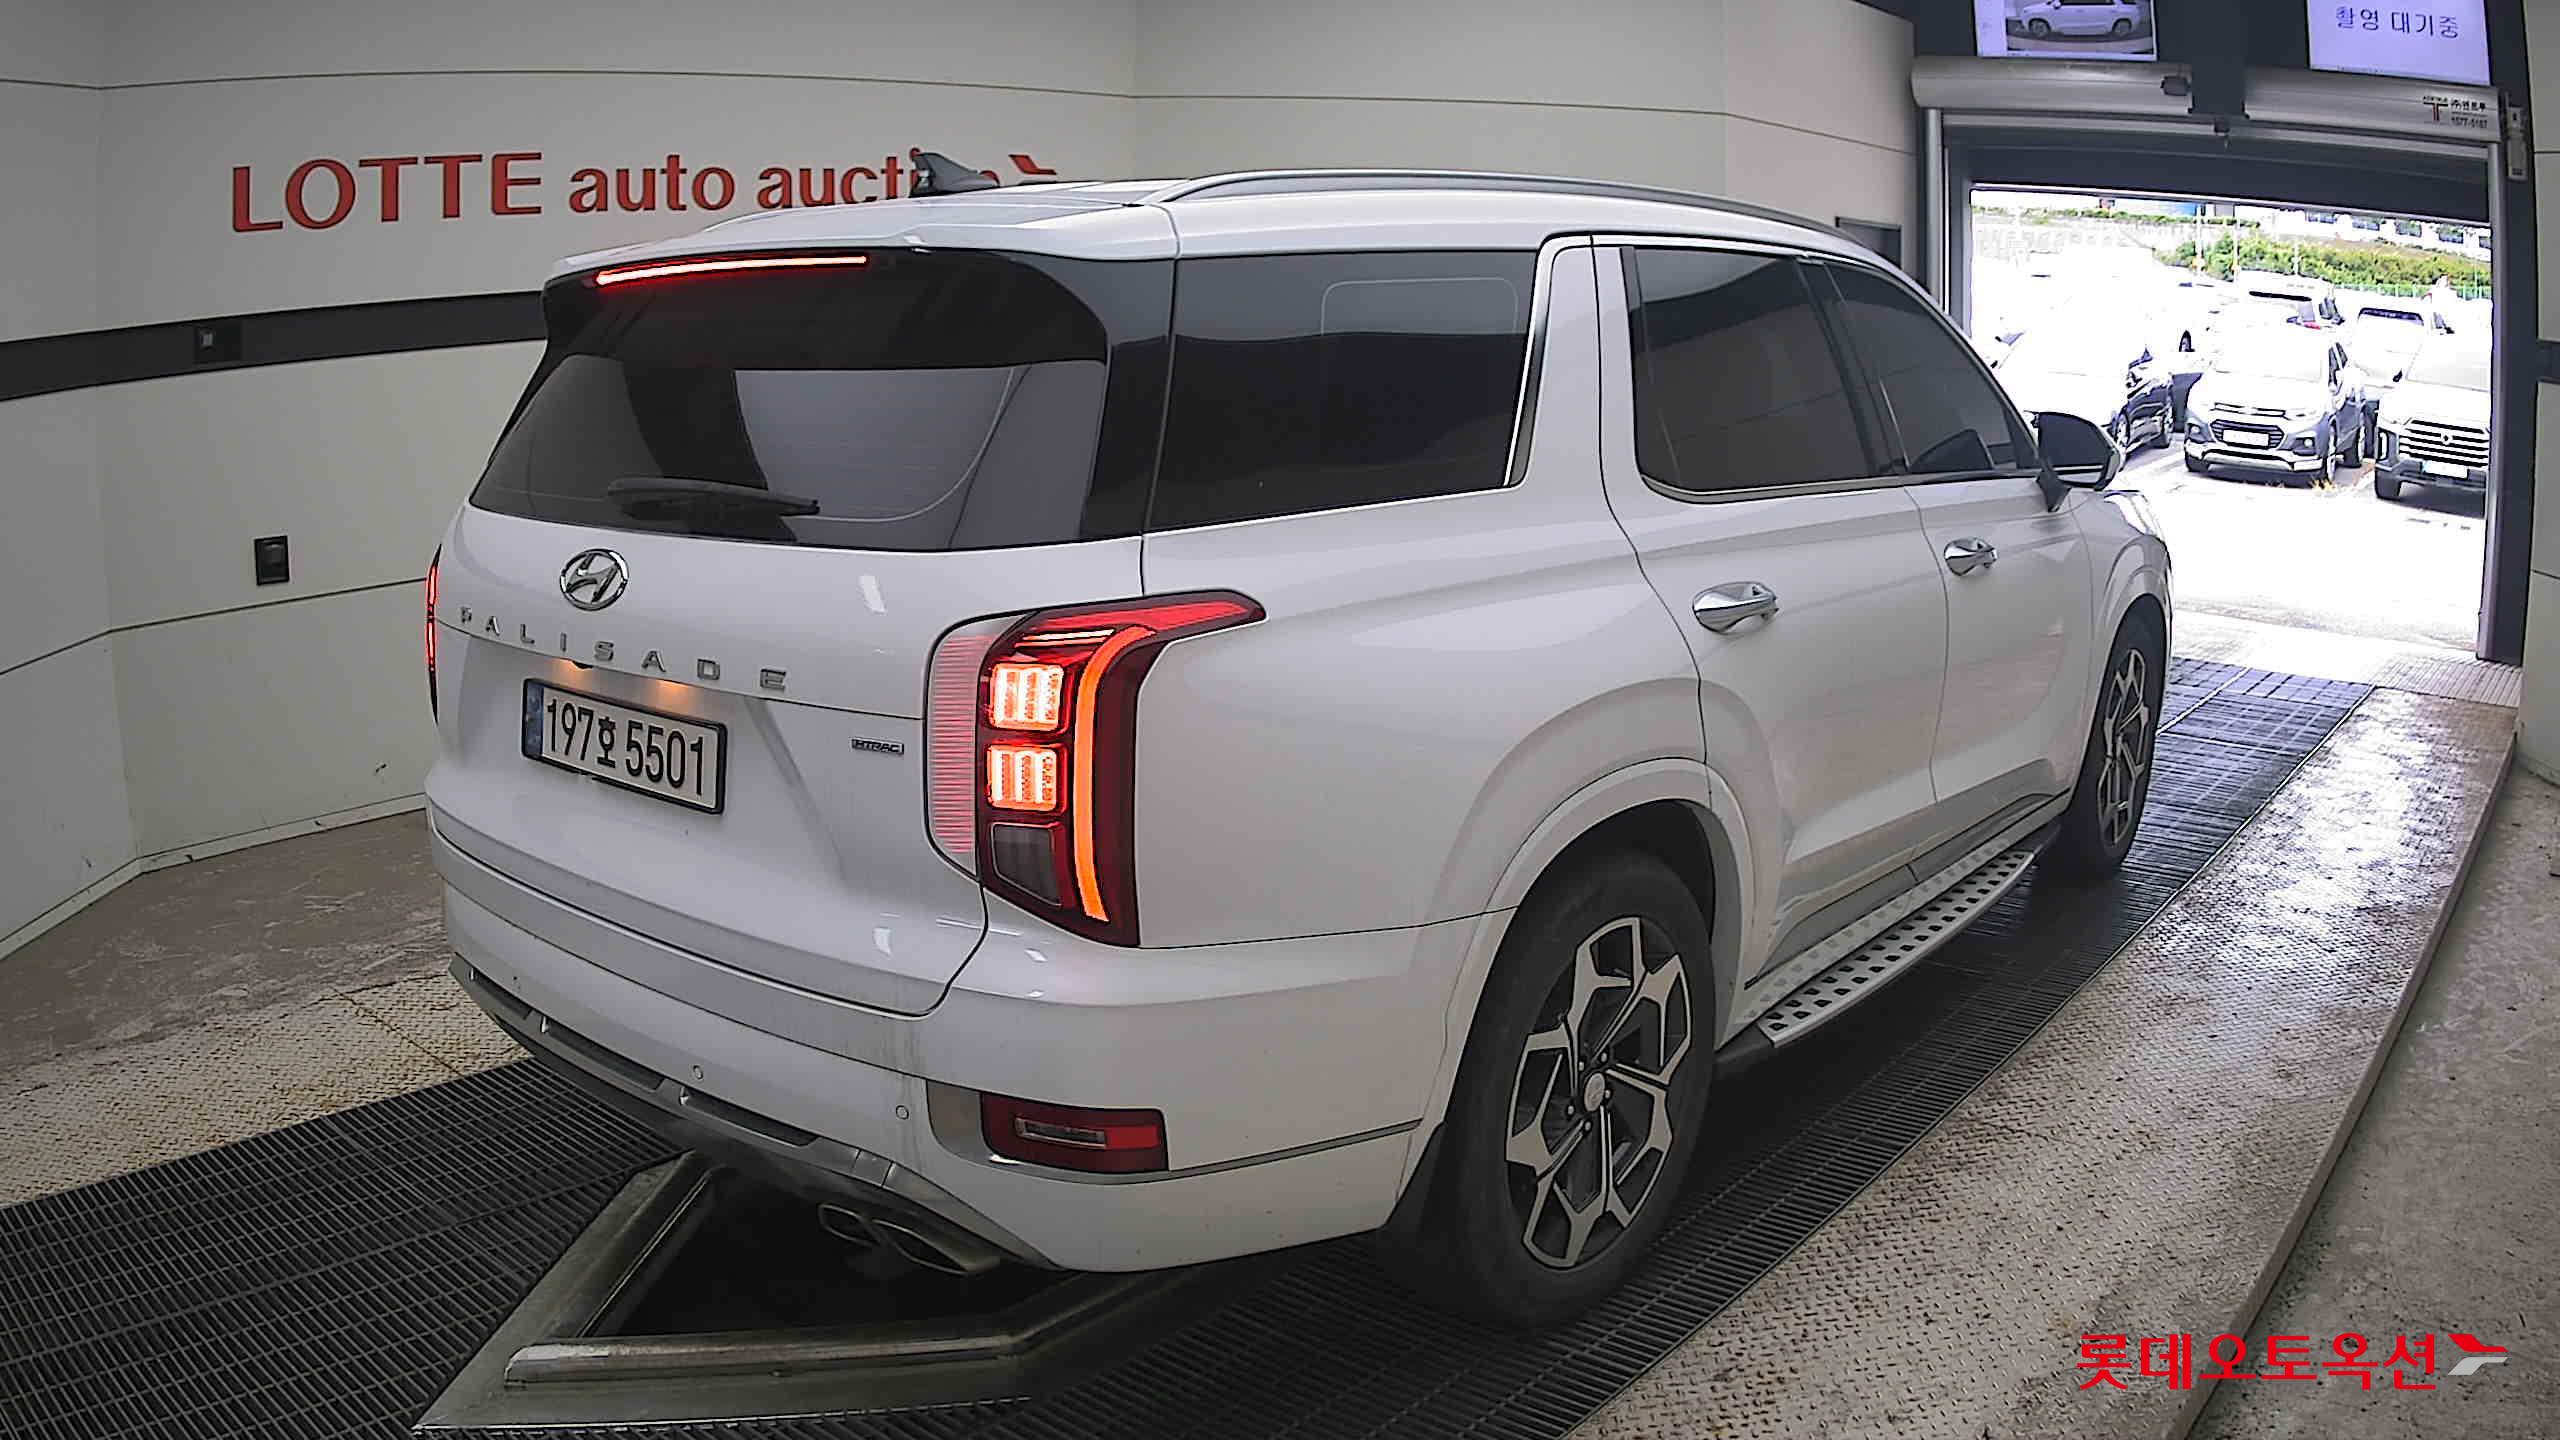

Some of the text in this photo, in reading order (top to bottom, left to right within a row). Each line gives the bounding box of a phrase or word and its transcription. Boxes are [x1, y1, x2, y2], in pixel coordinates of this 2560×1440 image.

[2336, 6, 2459, 39] 촬영 대기중
[232, 147, 1000, 233] LOTTE auto auct
[460, 606, 788, 691] PALISADE
[625, 719, 704, 797] 5501
